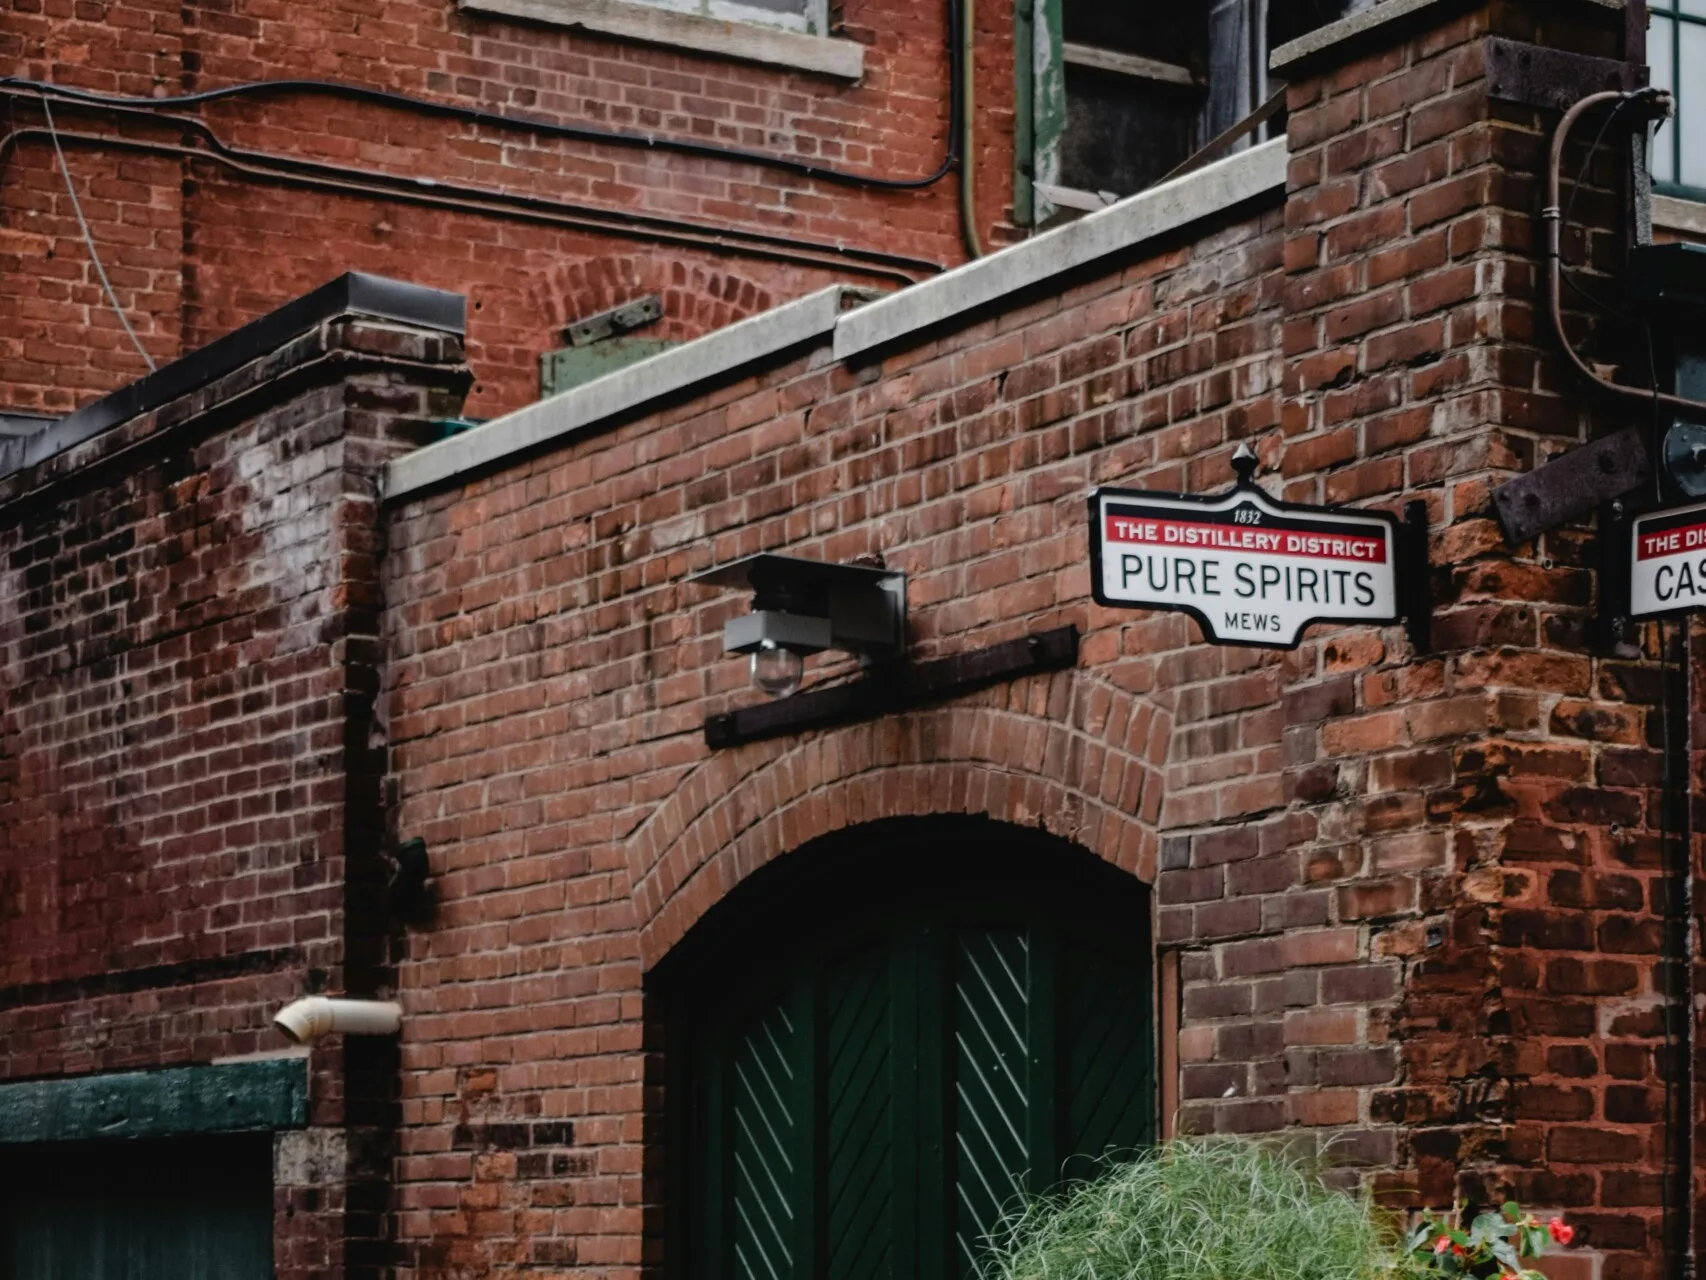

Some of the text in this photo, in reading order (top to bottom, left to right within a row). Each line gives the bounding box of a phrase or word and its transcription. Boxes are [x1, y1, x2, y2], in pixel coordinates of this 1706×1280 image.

[1234, 509, 1262, 525] 1832
[1115, 521, 1377, 558] THE DISTILLERY DISTRICT
[1645, 533, 1680, 554] THE
[1121, 554, 1376, 607] PURE SPIRITS
[1224, 611, 1281, 632] MEWS
